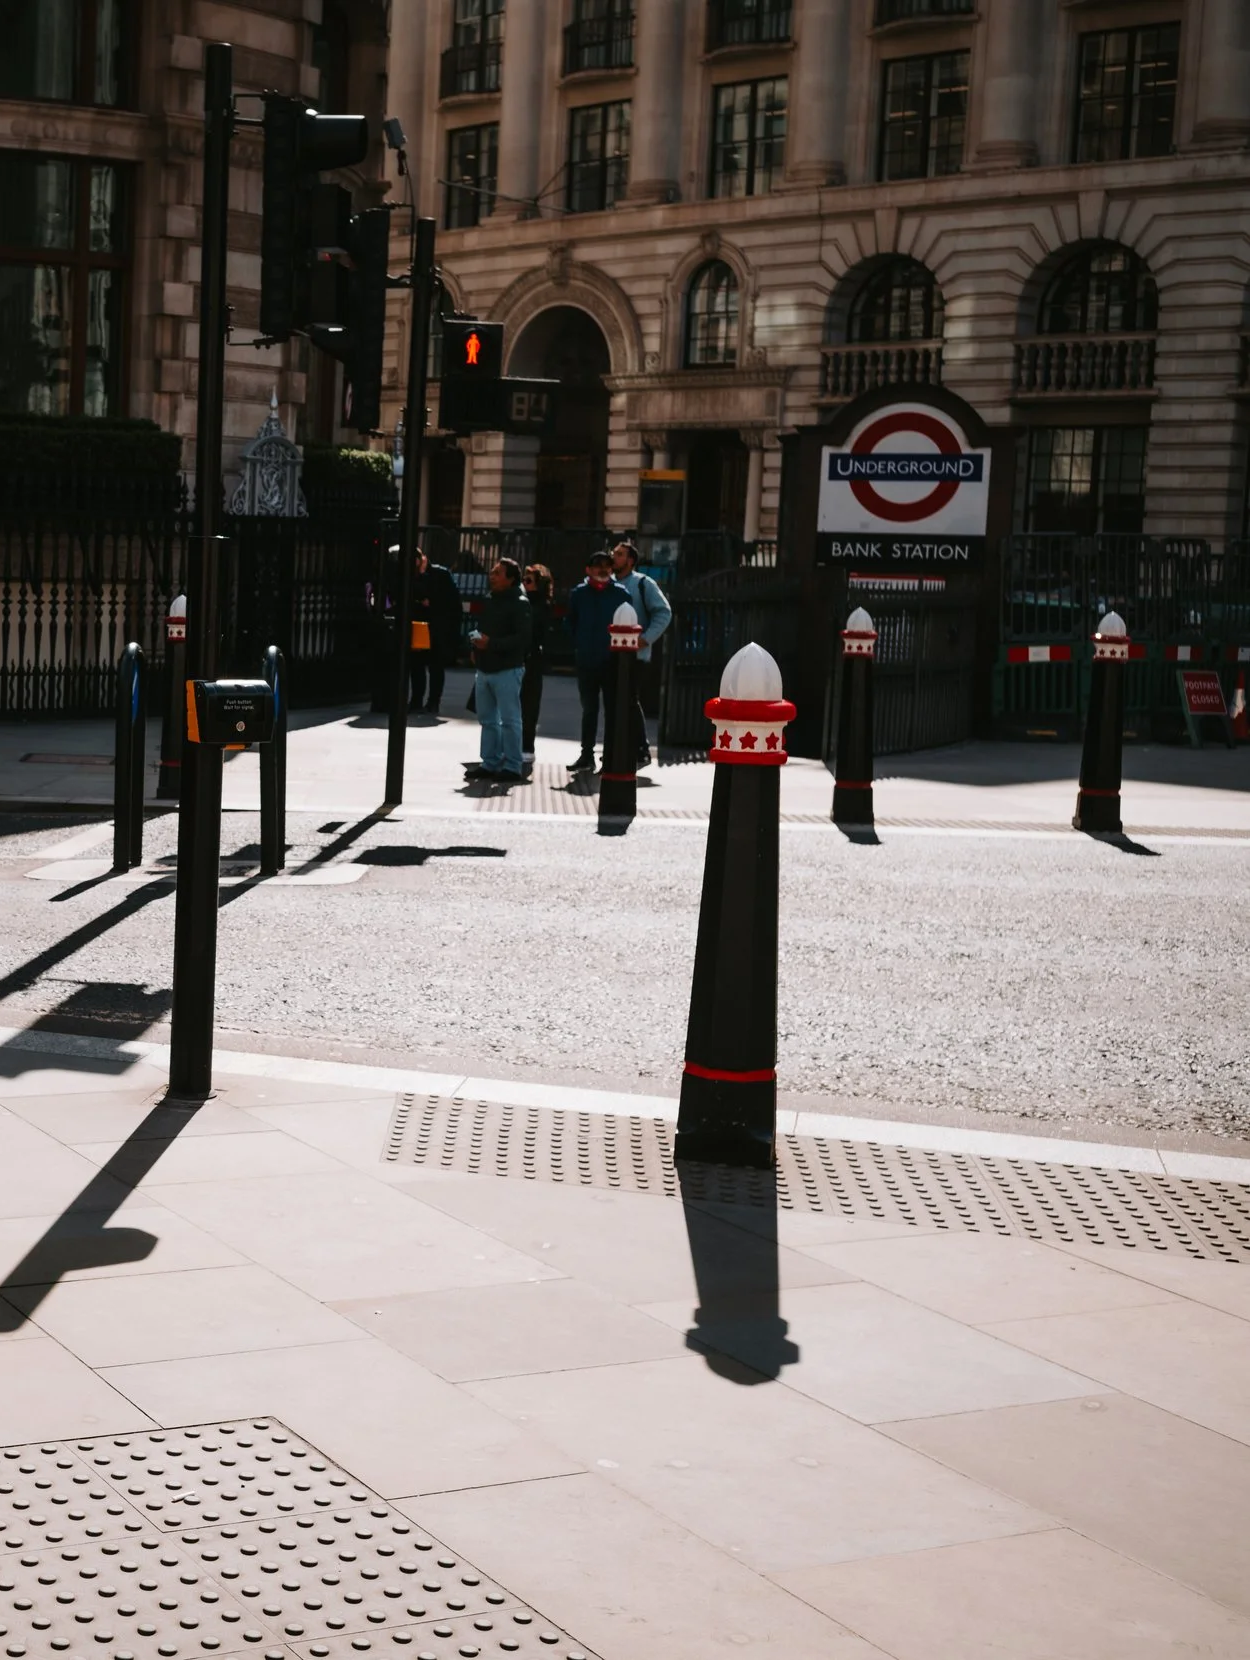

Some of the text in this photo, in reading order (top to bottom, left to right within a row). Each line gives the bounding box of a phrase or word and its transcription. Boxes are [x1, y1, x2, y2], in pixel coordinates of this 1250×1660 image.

[836, 458, 975, 477] UNDERGROUND
[831, 541, 969, 560] BANK STATION
[1184, 680, 1220, 690] FOOTPATH
[1191, 694, 1220, 704] CLOSED
